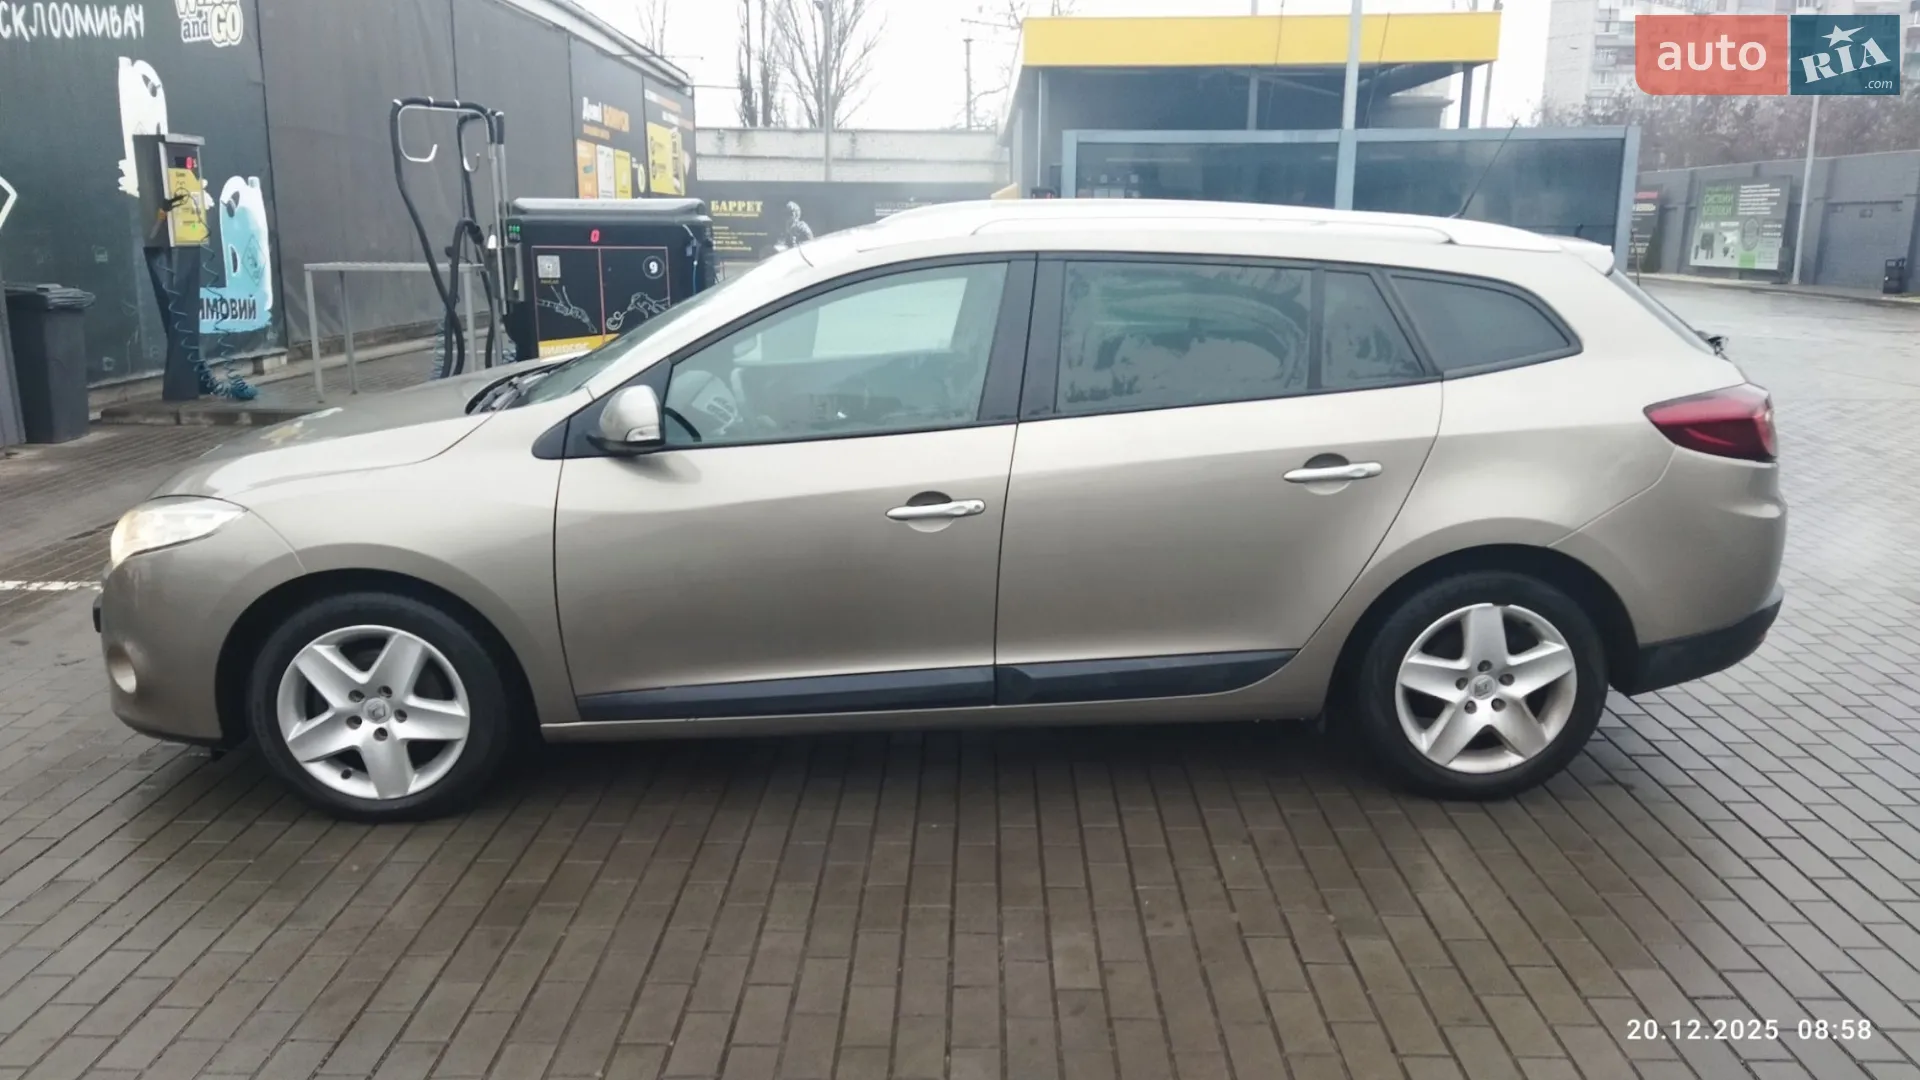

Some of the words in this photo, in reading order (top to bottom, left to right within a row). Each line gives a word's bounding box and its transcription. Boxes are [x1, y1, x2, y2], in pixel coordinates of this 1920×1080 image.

[182, 10, 210, 40] and
[210, 4, 242, 46] GO
[710, 200, 763, 213] БАРРЕТ
[590, 229, 600, 243] 0
[649, 261, 658, 274] 9
